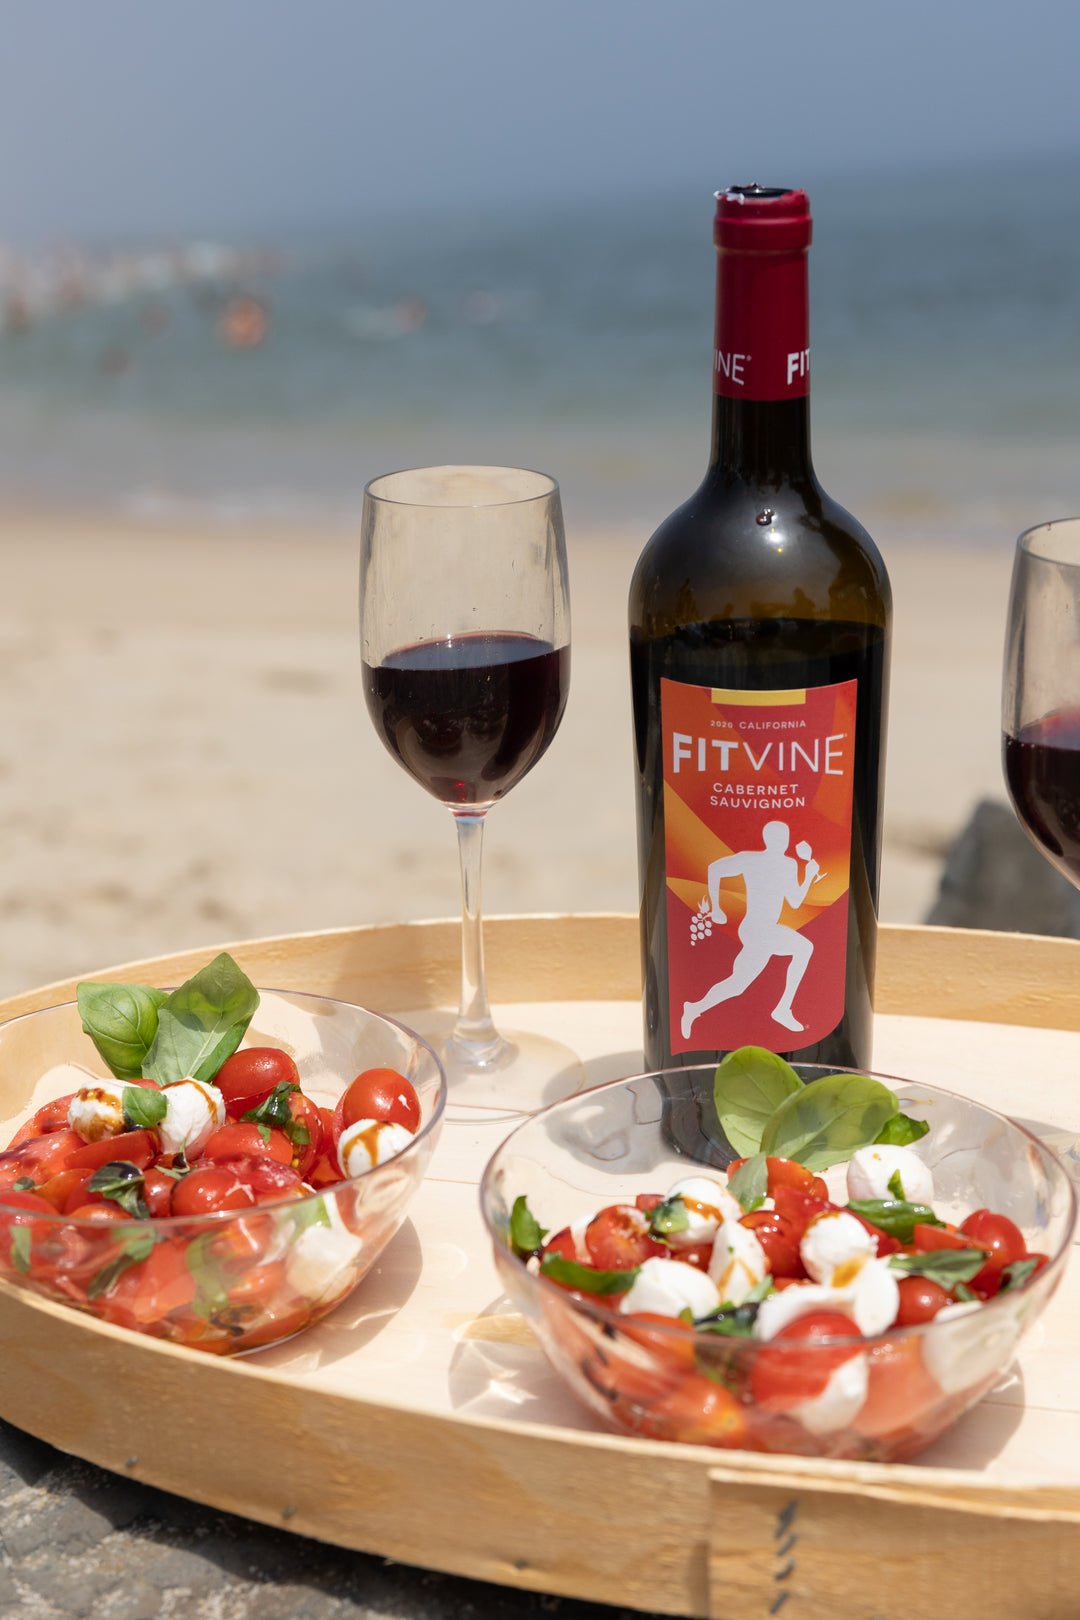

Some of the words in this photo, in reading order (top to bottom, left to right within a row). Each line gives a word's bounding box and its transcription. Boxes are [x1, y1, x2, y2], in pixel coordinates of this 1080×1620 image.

[710, 719, 733, 729] 2020
[739, 719, 807, 730] CALIFORNIA
[672, 731, 844, 775] FITVINE
[713, 782, 799, 795] CABERNET
[709, 795, 806, 810] SAUVIGNON
